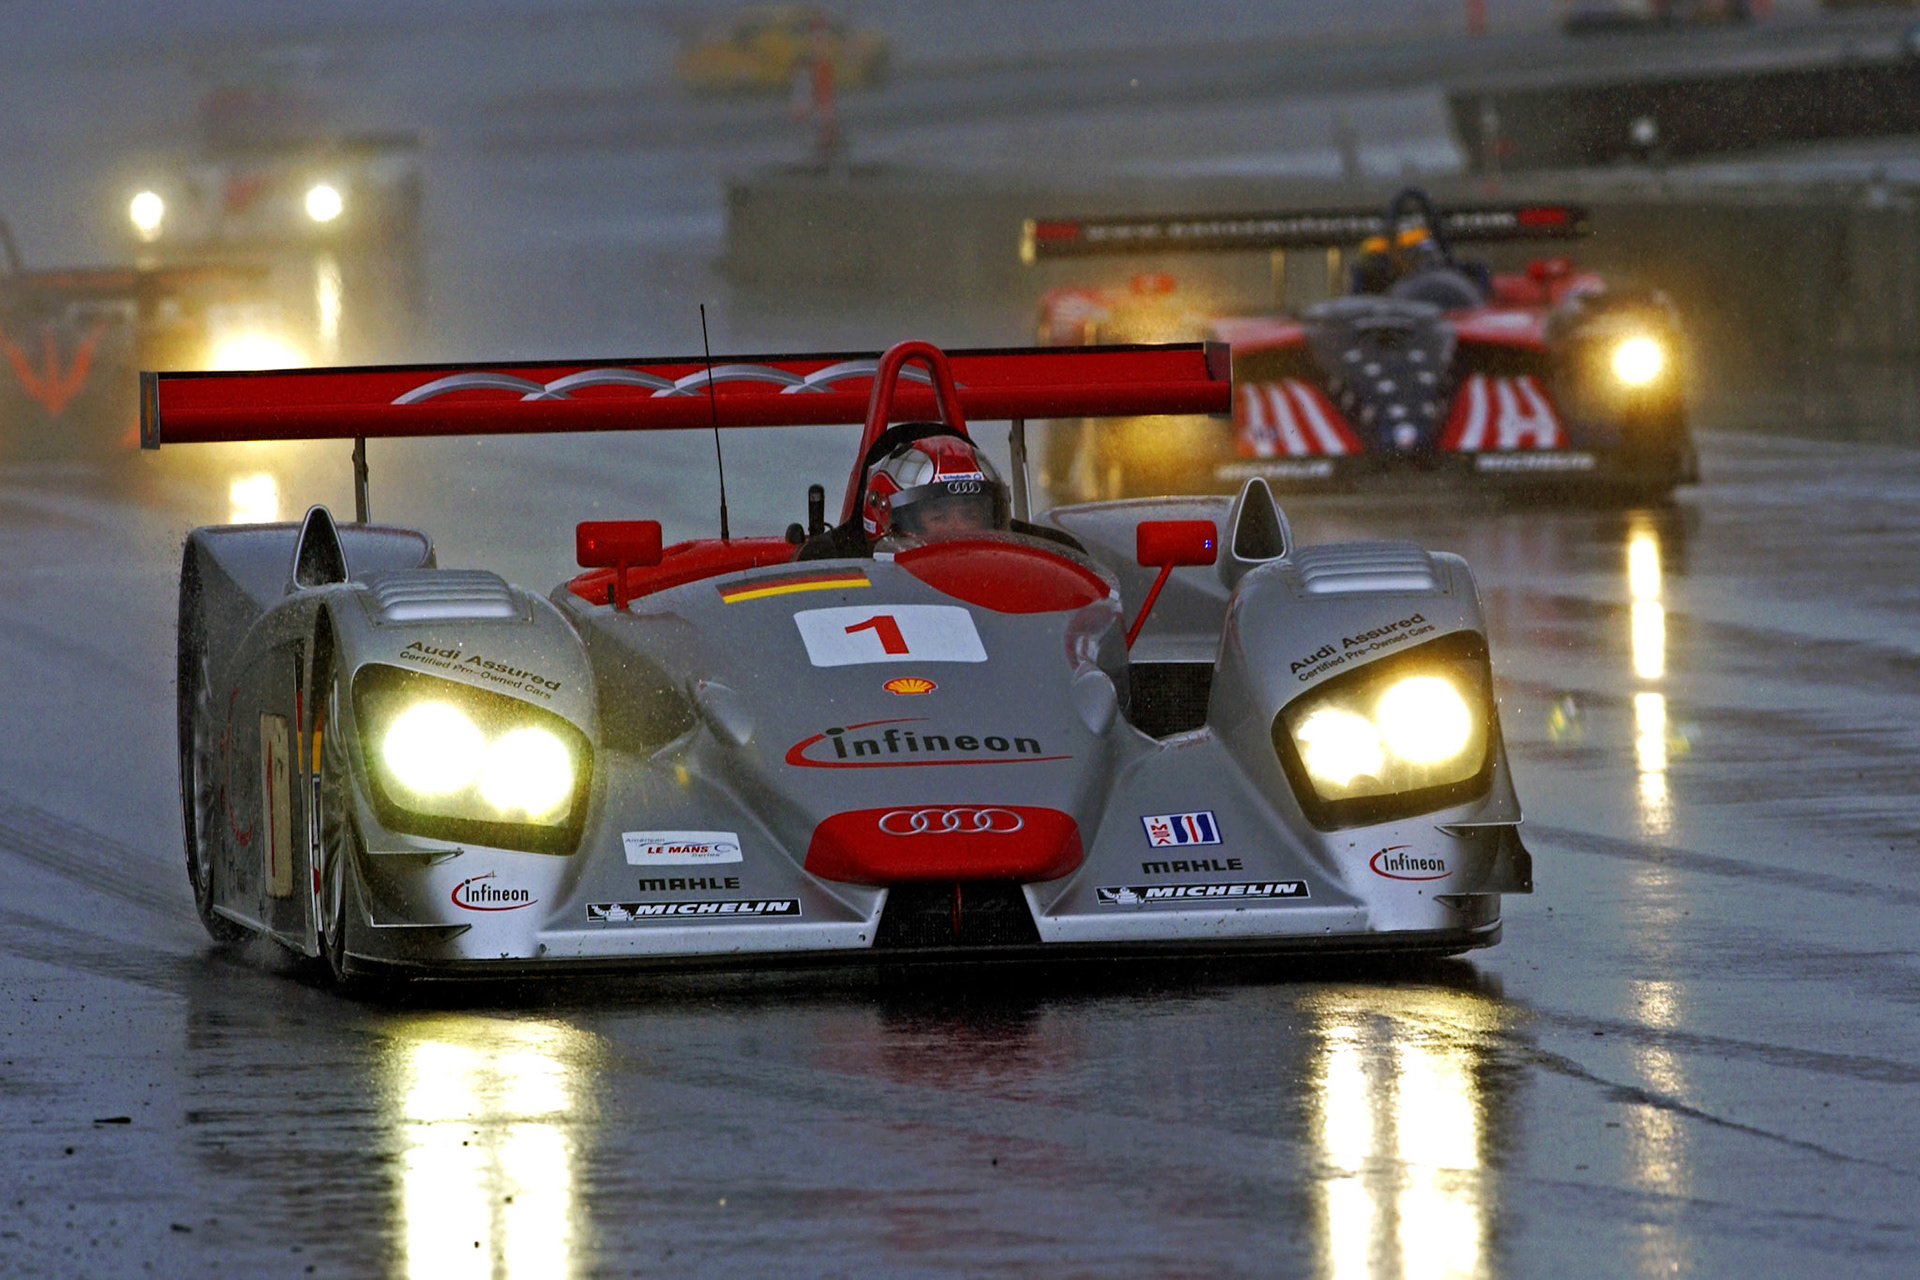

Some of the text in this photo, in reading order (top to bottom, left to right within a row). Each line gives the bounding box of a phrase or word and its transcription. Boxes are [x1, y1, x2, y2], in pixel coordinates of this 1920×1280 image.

[844, 615, 909, 654] 1
[1290, 613, 1426, 674] Audi Assured
[406, 641, 562, 691] Audi Assured
[1298, 623, 1436, 682] Certified Pre-Owned Cars
[400, 651, 552, 699] Certified Pre-Owned Cars
[647, 845, 710, 854] LE MANS
[1141, 858, 1244, 874] MAHLE
[638, 877, 741, 892] MAHLE
[1144, 883, 1299, 898] MICHELIN
[635, 901, 791, 915] MICHELIN
